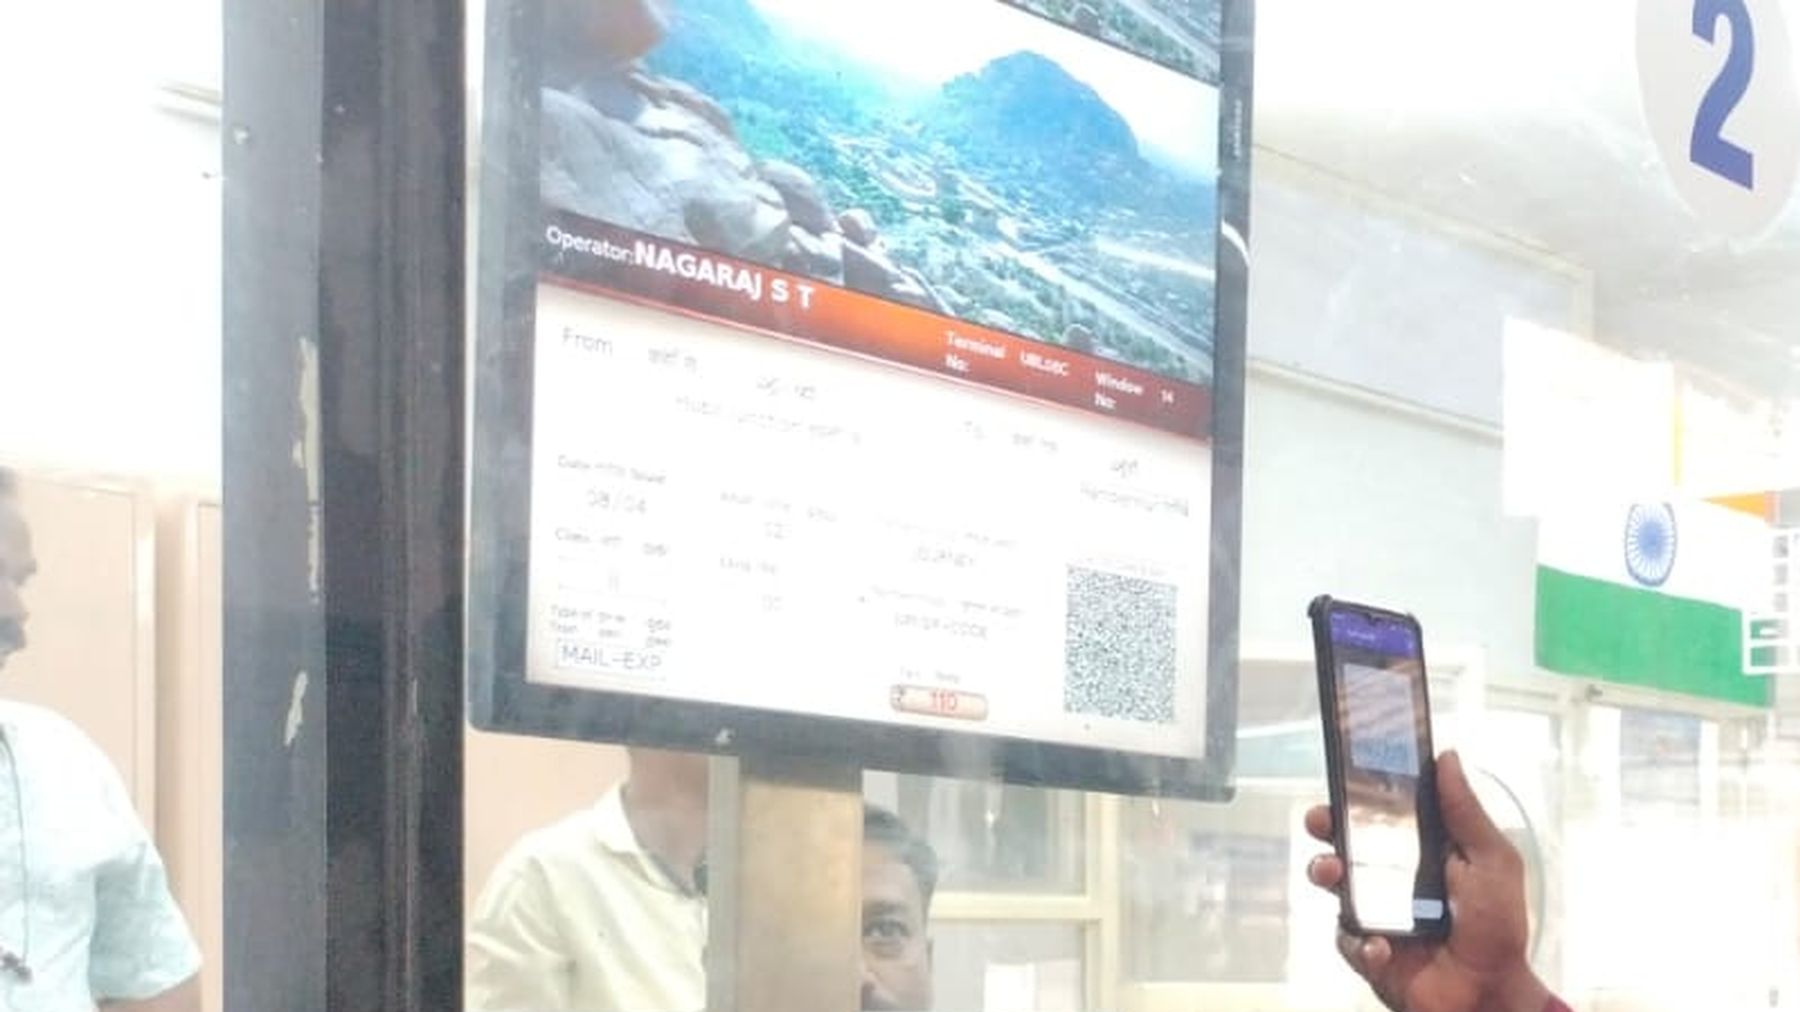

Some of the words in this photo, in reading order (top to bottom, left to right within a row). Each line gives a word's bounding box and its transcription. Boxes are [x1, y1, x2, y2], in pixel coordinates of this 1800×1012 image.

[1690, 0, 1755, 190] 2
[634, 241, 762, 300] NAGARAJ
[771, 279, 788, 302] S
[797, 285, 815, 308] T
[561, 326, 613, 357] From
[947, 331, 1007, 358] Terminal
[1095, 370, 1144, 396] Window
[561, 644, 664, 671] MAIL-EXP
